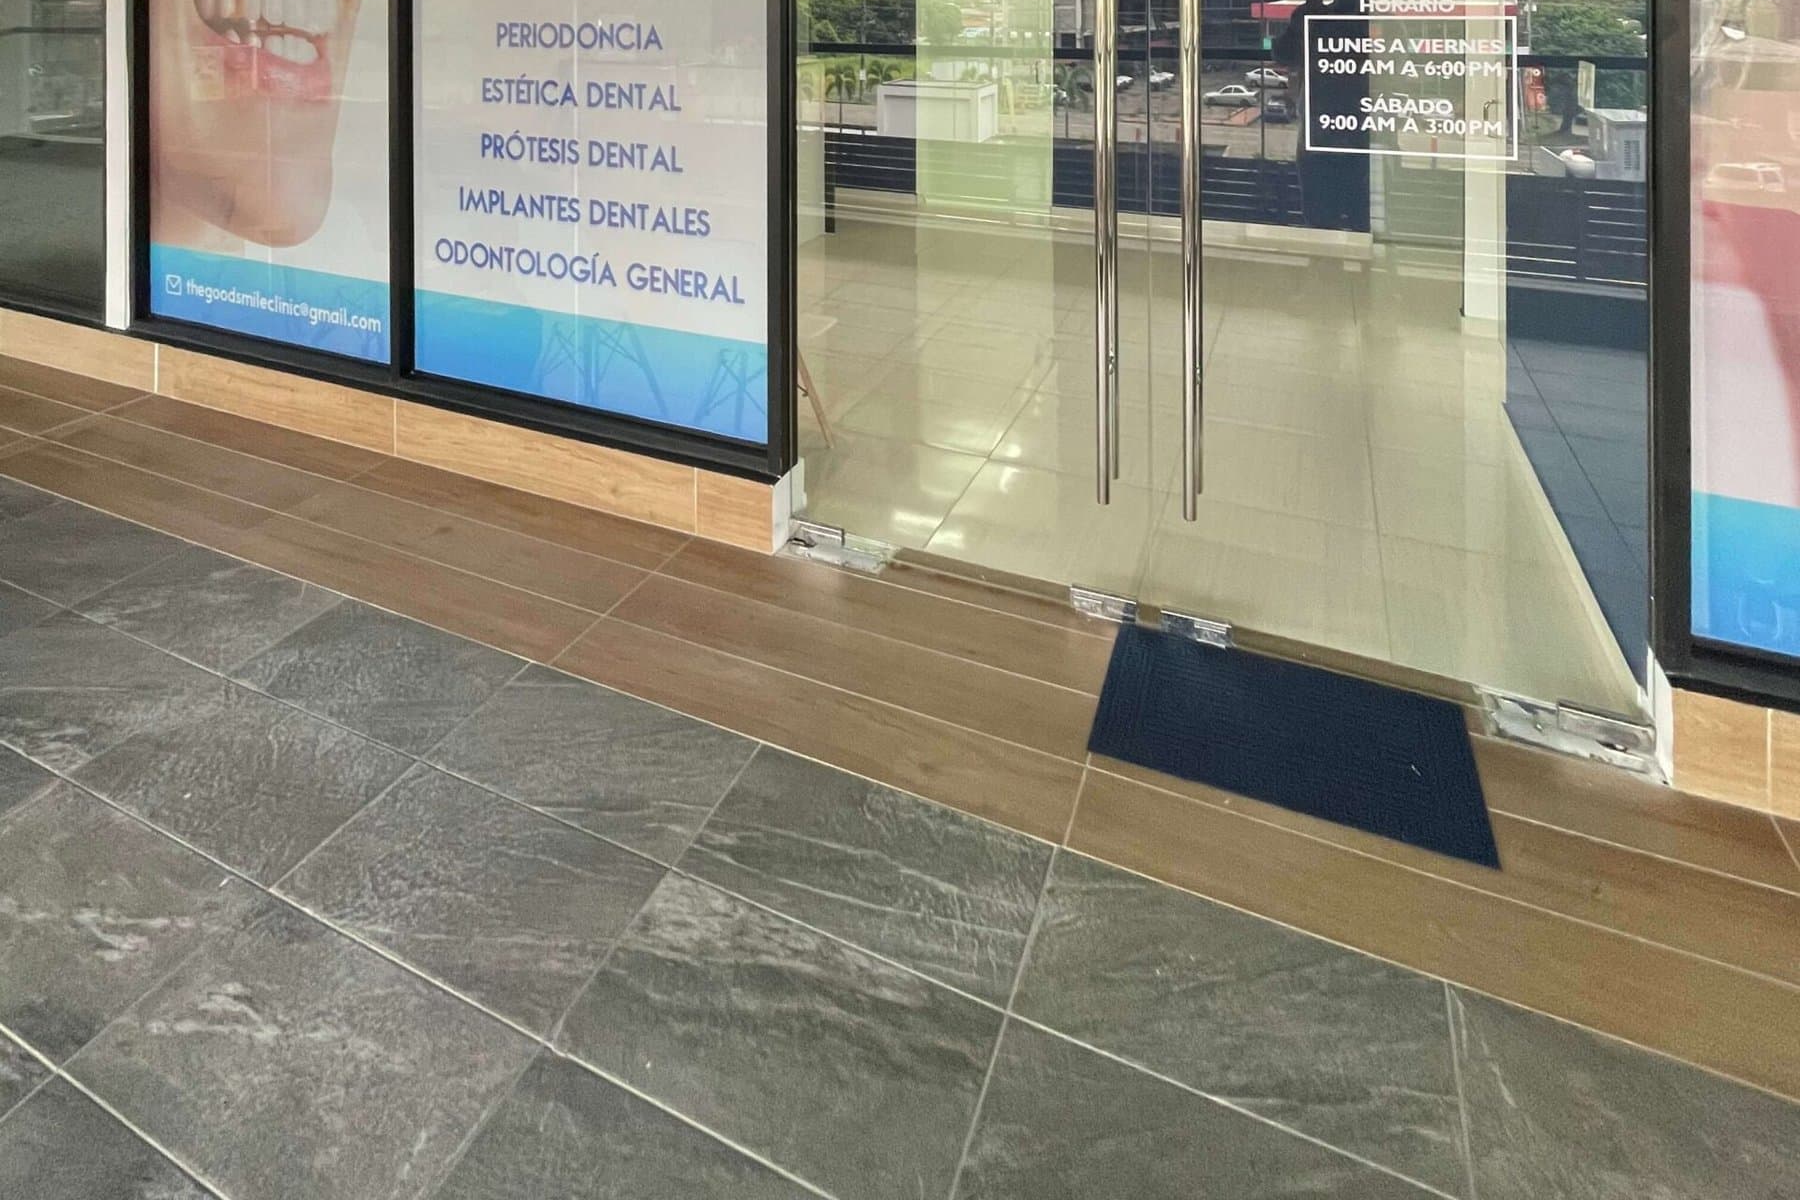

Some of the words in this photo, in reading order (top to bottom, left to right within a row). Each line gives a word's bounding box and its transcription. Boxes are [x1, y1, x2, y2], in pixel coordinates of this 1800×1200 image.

[496, 22, 663, 50] PERIODONCIA
[1317, 37, 1386, 54] LUNES
[1388, 38, 1406, 54] A
[1408, 38, 1504, 55] VIERNES
[1317, 58, 1357, 75] 9:00
[1360, 59, 1395, 76] AM
[1400, 60, 1418, 76] A
[1424, 60, 1466, 78] 6:00
[1468, 62, 1503, 78] PM
[482, 72, 579, 108] ESTÉTICA
[587, 81, 682, 112] DENTAL
[1359, 92, 1454, 115] SÁBADO
[1319, 115, 1358, 131] 9:00
[1361, 116, 1396, 133] AM
[1402, 116, 1420, 134] A
[1425, 117, 1466, 135] 3:00
[1469, 120, 1503, 136] PM
[480, 129, 580, 165] PRÓTESIS
[587, 140, 684, 174] DENTAL
[459, 186, 581, 224] IMPLANTES
[589, 199, 711, 238] DENTALES
[435, 237, 617, 287] ODONTOLOGÍA
[626, 262, 746, 304] GENERAL
[186, 278, 382, 333] thegoodsmileclinic@gmail.com
